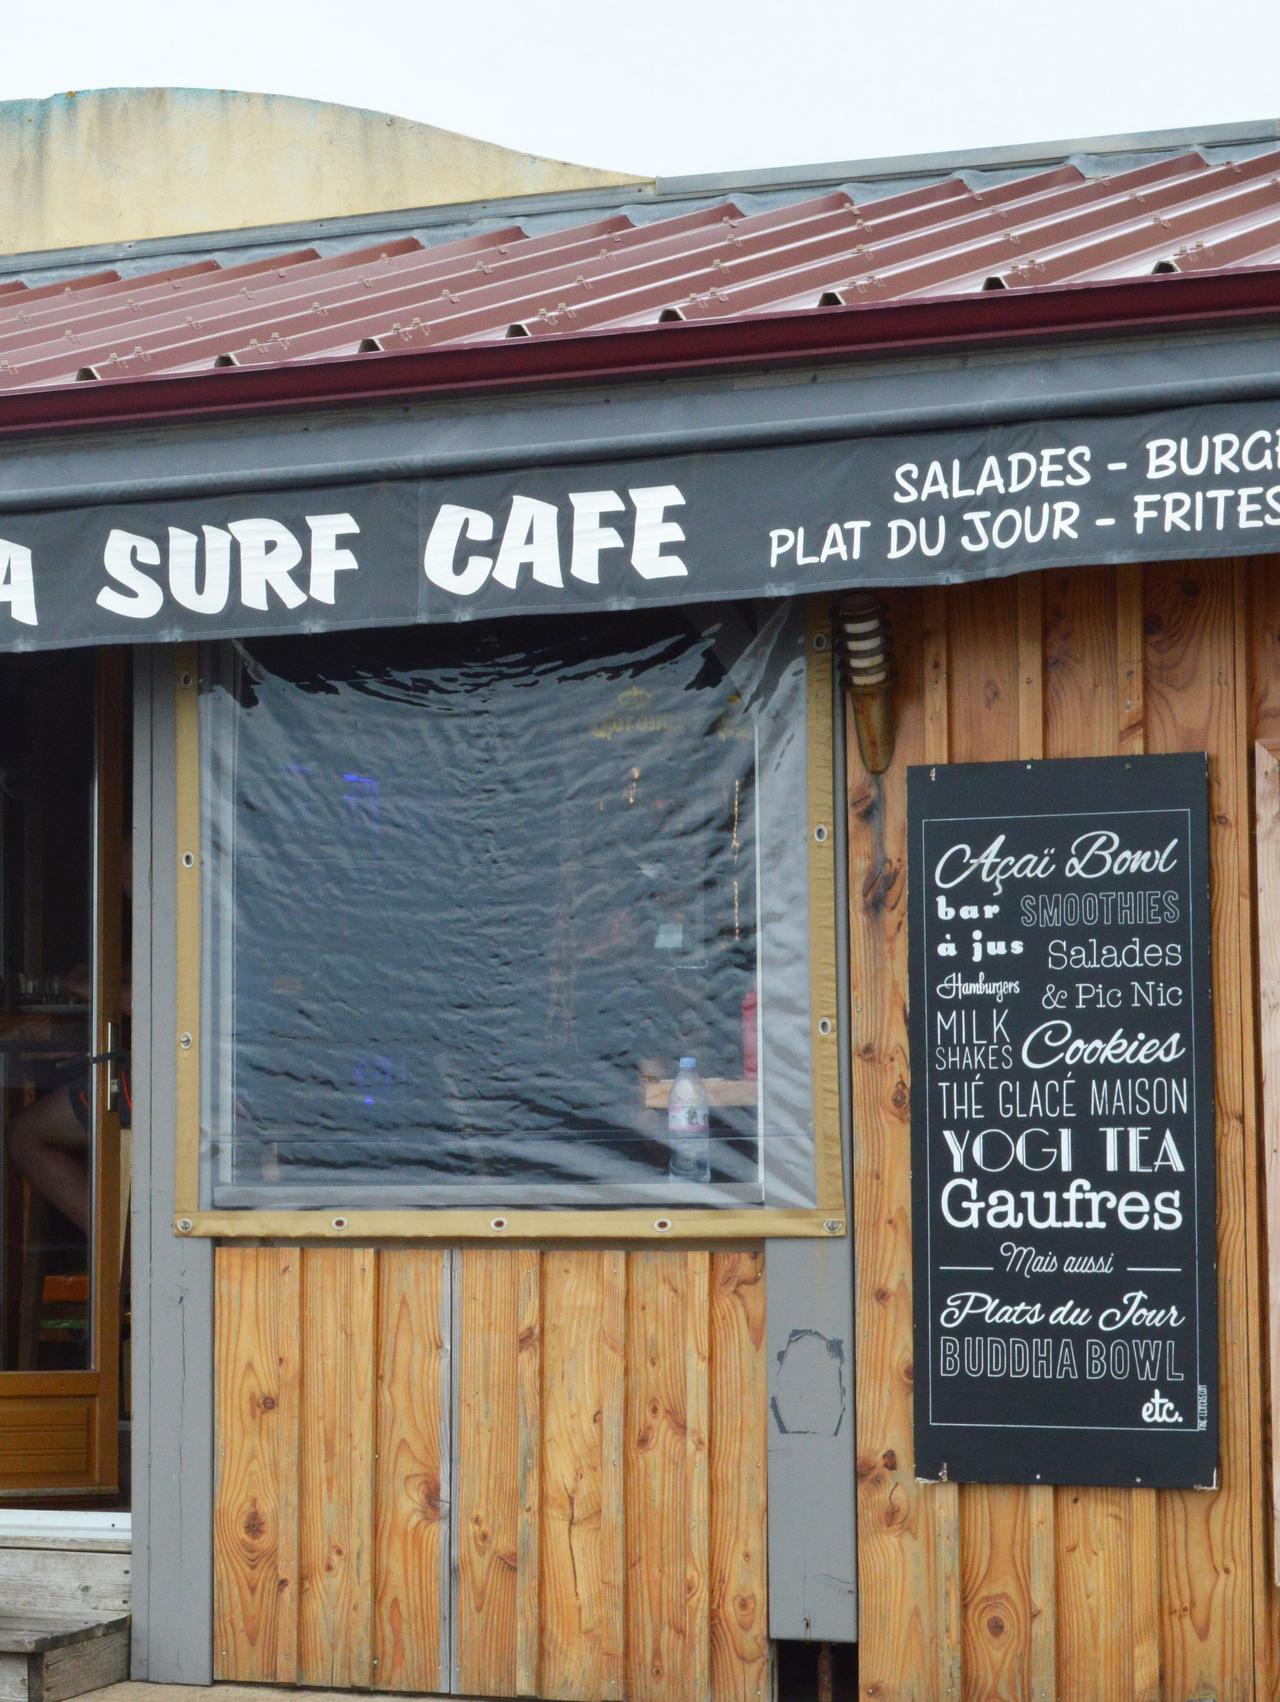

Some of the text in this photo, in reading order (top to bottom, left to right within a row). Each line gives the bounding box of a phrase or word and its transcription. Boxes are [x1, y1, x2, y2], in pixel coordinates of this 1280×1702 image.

[894, 446, 1090, 503] SALADES
[1146, 429, 1280, 479] BURG
[770, 521, 871, 567] PLAT
[887, 516, 945, 559] DU
[960, 501, 1080, 551] JOUR
[1134, 485, 1280, 534] FRITES
[96, 513, 360, 618] SURF
[424, 485, 688, 595] CAFE
[935, 831, 1178, 895] Açaï Bowl
[936, 896, 1000, 920] bar
[1021, 890, 1179, 927] SMOOTHIES
[972, 930, 1023, 962] jus
[1049, 938, 1181, 970] Salades
[936, 972, 1020, 1003] Hamburgers
[1042, 982, 1182, 1009] & Pic Nic
[937, 1008, 1010, 1046] MILK
[1022, 1020, 1185, 1069] Cookies
[936, 1045, 1012, 1070] SHAKES
[938, 1071, 1187, 1119] THÉ GLACÉ MAISON
[943, 1127, 1185, 1172] YOGI TEA
[941, 1178, 1182, 1230] Gaufres
[1000, 1242, 1114, 1278] Mais aussi
[940, 1290, 1185, 1331] Plats du Jour
[941, 1336, 1184, 1381] BUDDHA BOWL
[1142, 1389, 1183, 1422] etc.
